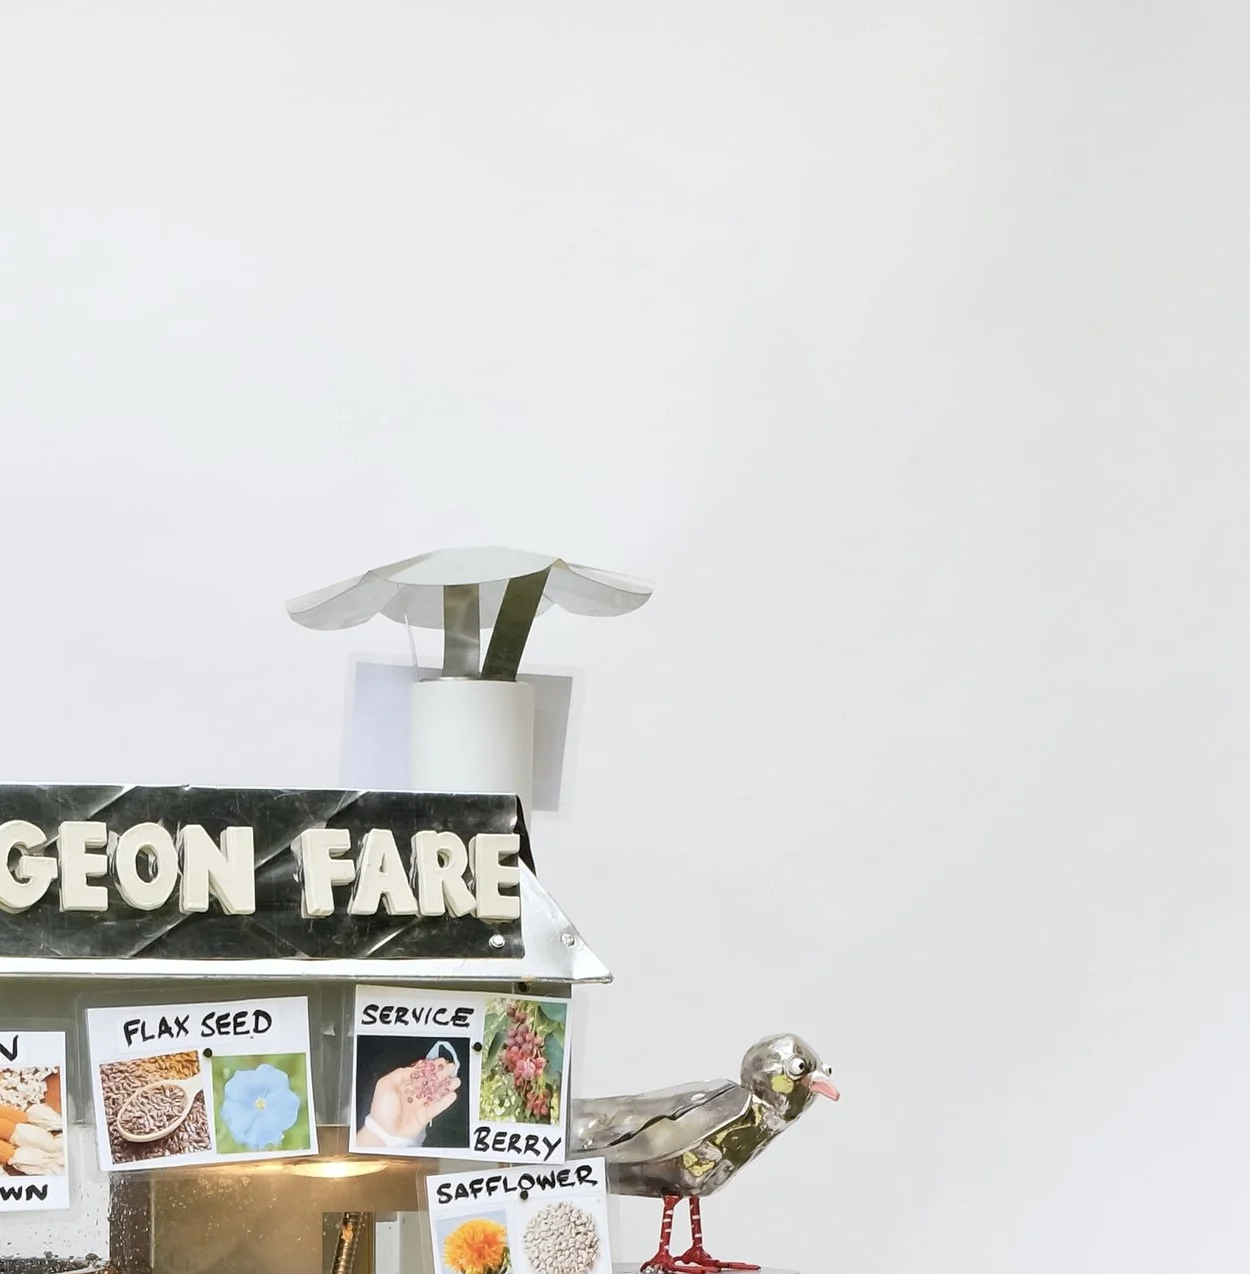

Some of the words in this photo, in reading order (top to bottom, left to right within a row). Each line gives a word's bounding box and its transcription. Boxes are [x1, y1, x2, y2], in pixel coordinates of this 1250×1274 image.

[301, 829, 522, 919] FARE
[123, 1014, 190, 1046] FLAX
[200, 1009, 273, 1038] SEED
[361, 1004, 475, 1028] SERVICE
[473, 1126, 563, 1161] BERRY
[436, 1164, 599, 1205] SAFFLOWER
